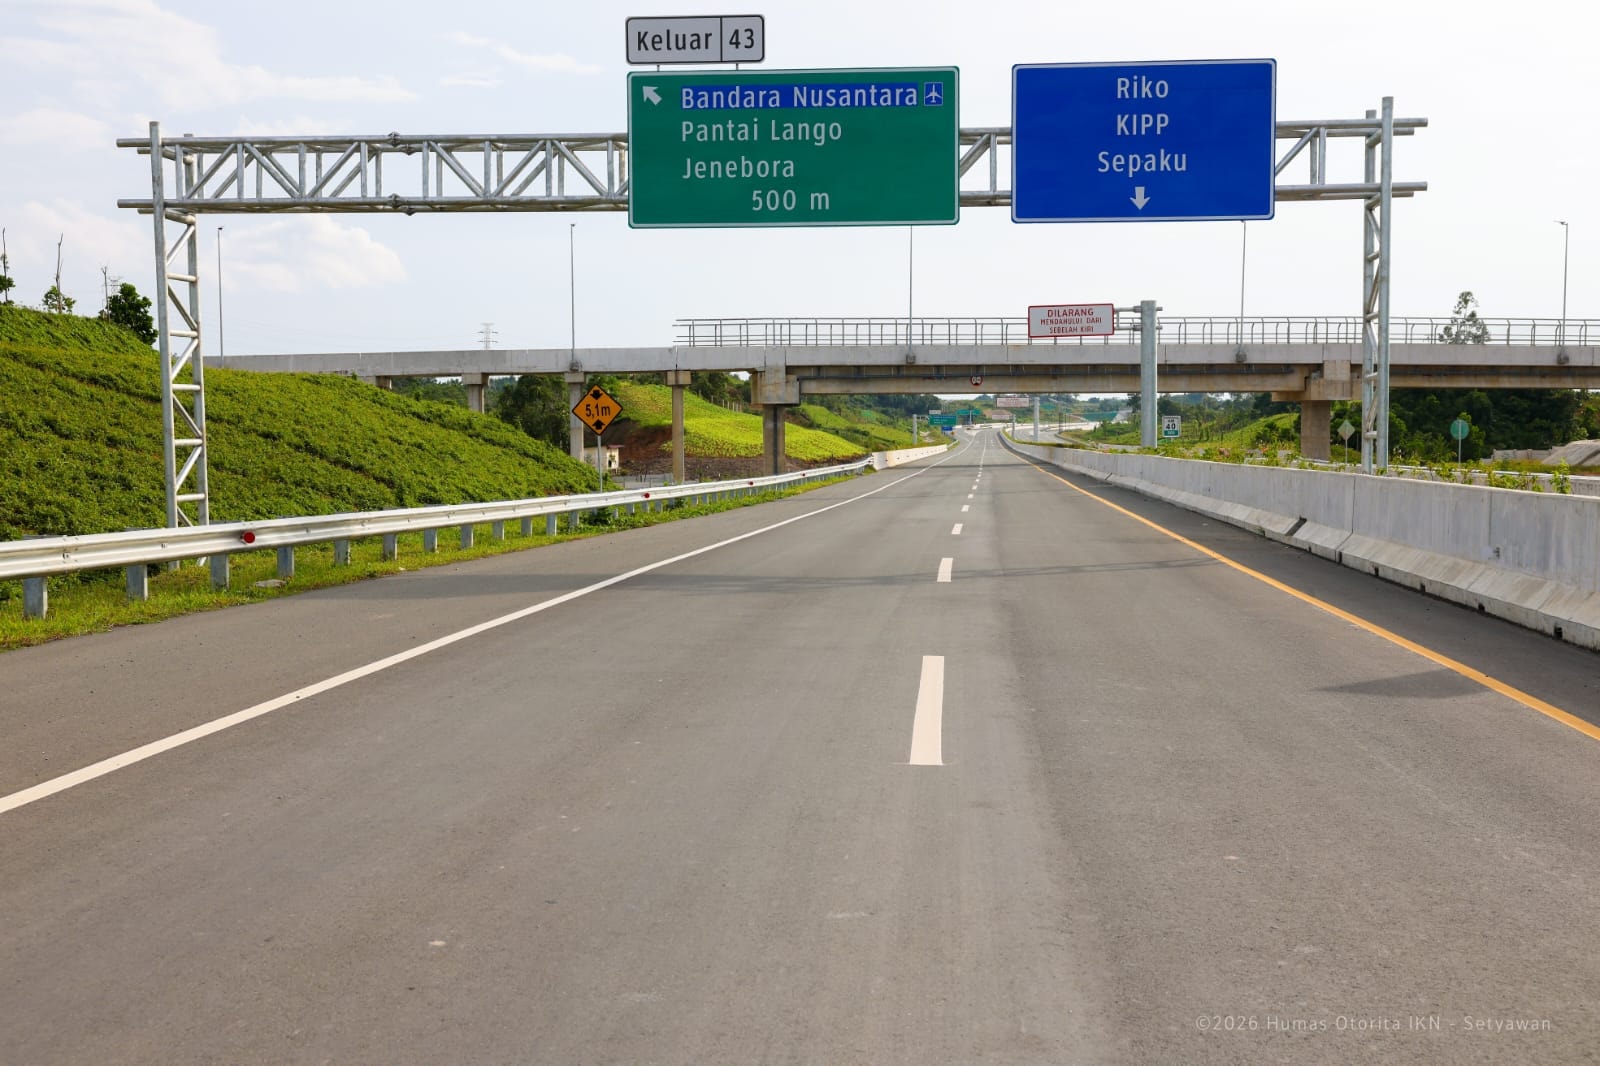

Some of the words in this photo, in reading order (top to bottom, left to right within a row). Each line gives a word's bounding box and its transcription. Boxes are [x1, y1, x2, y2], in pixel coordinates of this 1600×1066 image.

[637, 29, 712, 51] Keluar
[729, 28, 755, 49] 43
[681, 86, 781, 109] Bandara
[793, 84, 918, 107] Nusantara
[1117, 75, 1169, 99] Riko
[681, 118, 759, 142] Pantai
[771, 119, 842, 146] Lango
[1117, 113, 1169, 136] KIPP
[682, 156, 795, 179] Jenebora
[1098, 148, 1187, 178] Sepaku
[752, 189, 797, 211] 500
[810, 191, 830, 210] m
[1040, 317, 1083, 326] MENDAHULUI
[1047, 308, 1094, 318] DILARANG
[1049, 326, 1078, 334] SEBELAH
[1081, 325, 1094, 333] KIRI
